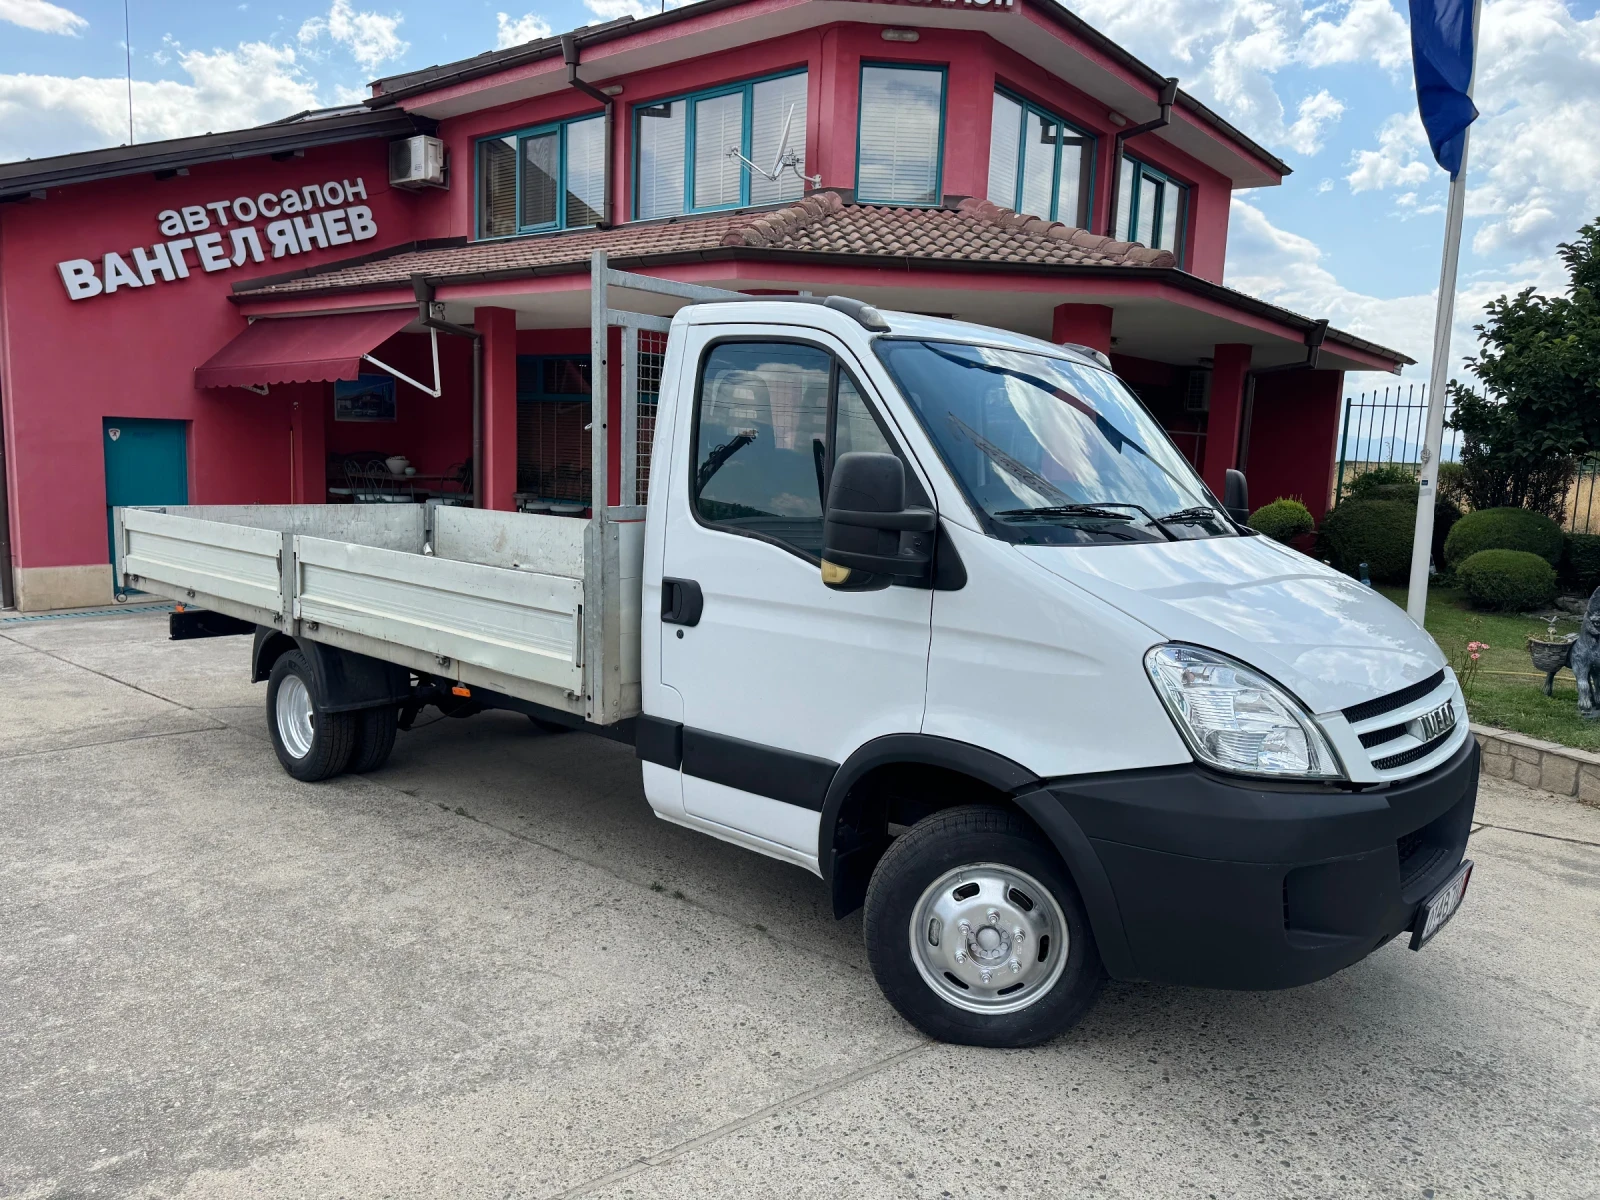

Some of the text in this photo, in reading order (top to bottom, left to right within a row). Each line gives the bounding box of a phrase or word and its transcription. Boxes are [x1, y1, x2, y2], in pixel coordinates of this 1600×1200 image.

[158, 177, 368, 236] автосалон
[58, 205, 378, 301] ВАНГЕЛ ЯНЕВ
